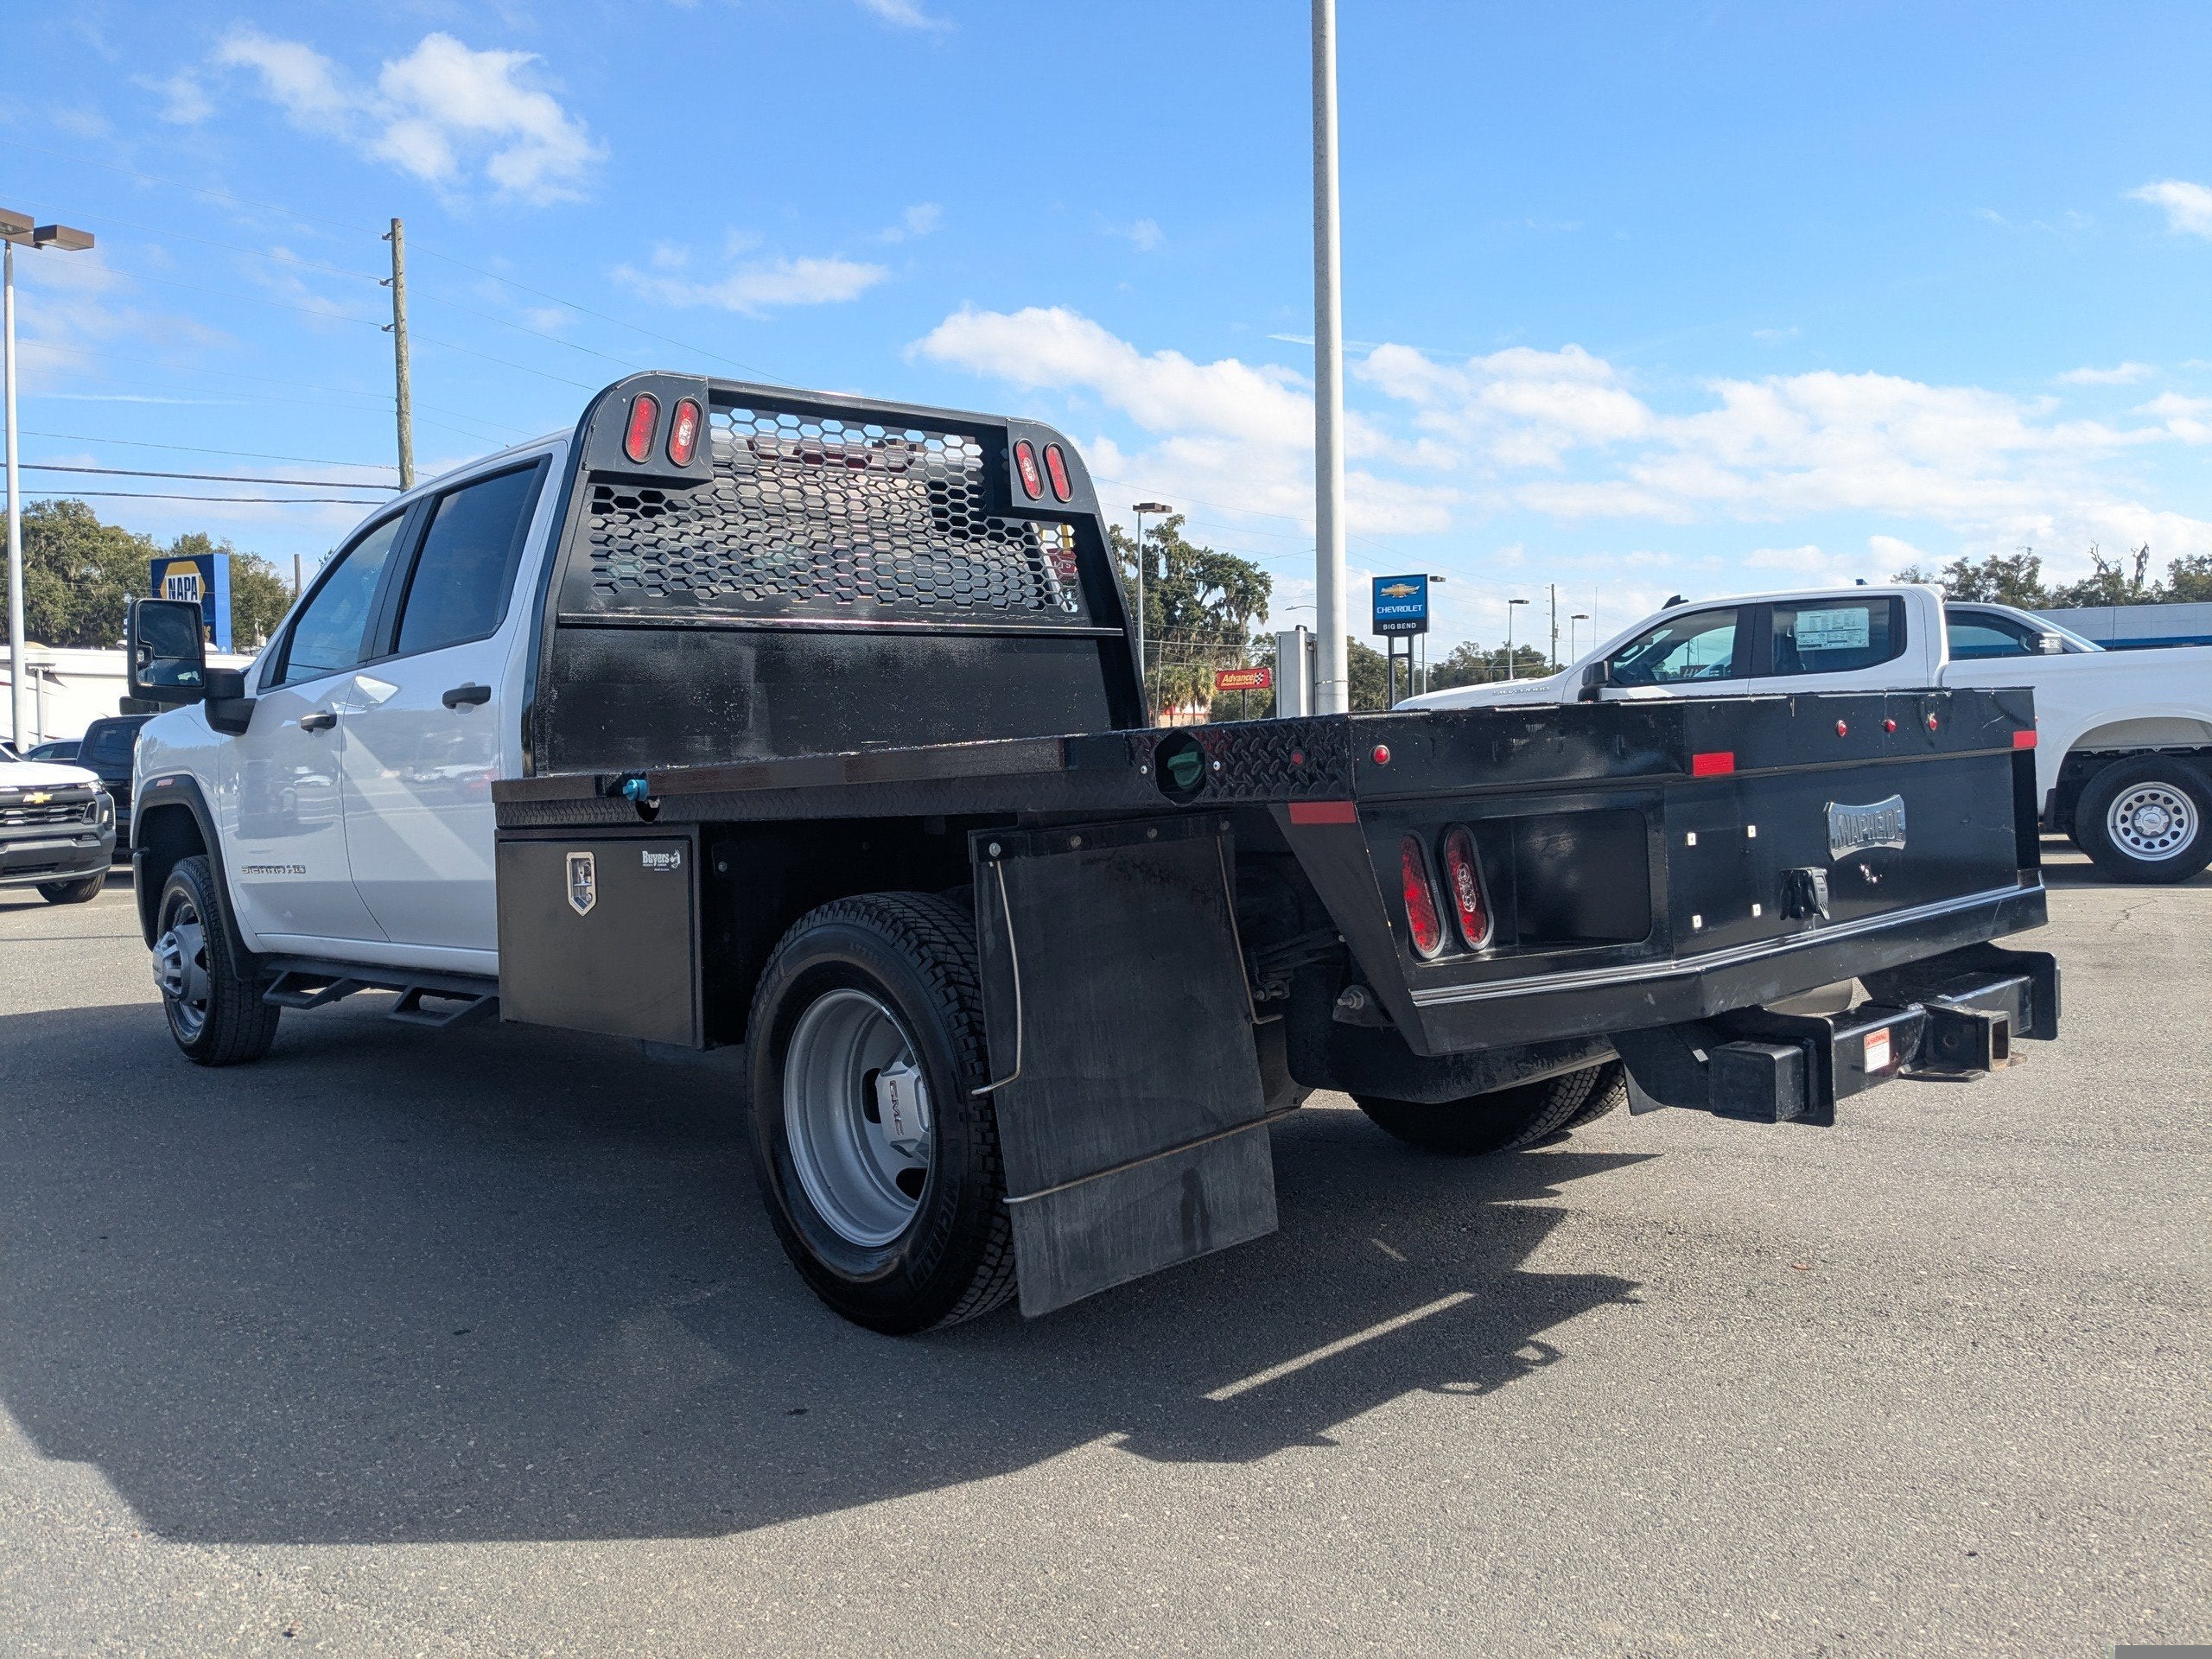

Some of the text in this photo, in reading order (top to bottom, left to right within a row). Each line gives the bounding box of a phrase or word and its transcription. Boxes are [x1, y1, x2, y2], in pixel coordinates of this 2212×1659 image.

[168, 575, 198, 601] NAPA
[1376, 604, 1422, 613] CHEVROLET
[1222, 674, 1254, 683] Advance
[1833, 807, 1904, 850] KNAPHEIDE
[642, 850, 670, 867] Buyers
[889, 1079, 905, 1136] GMC
